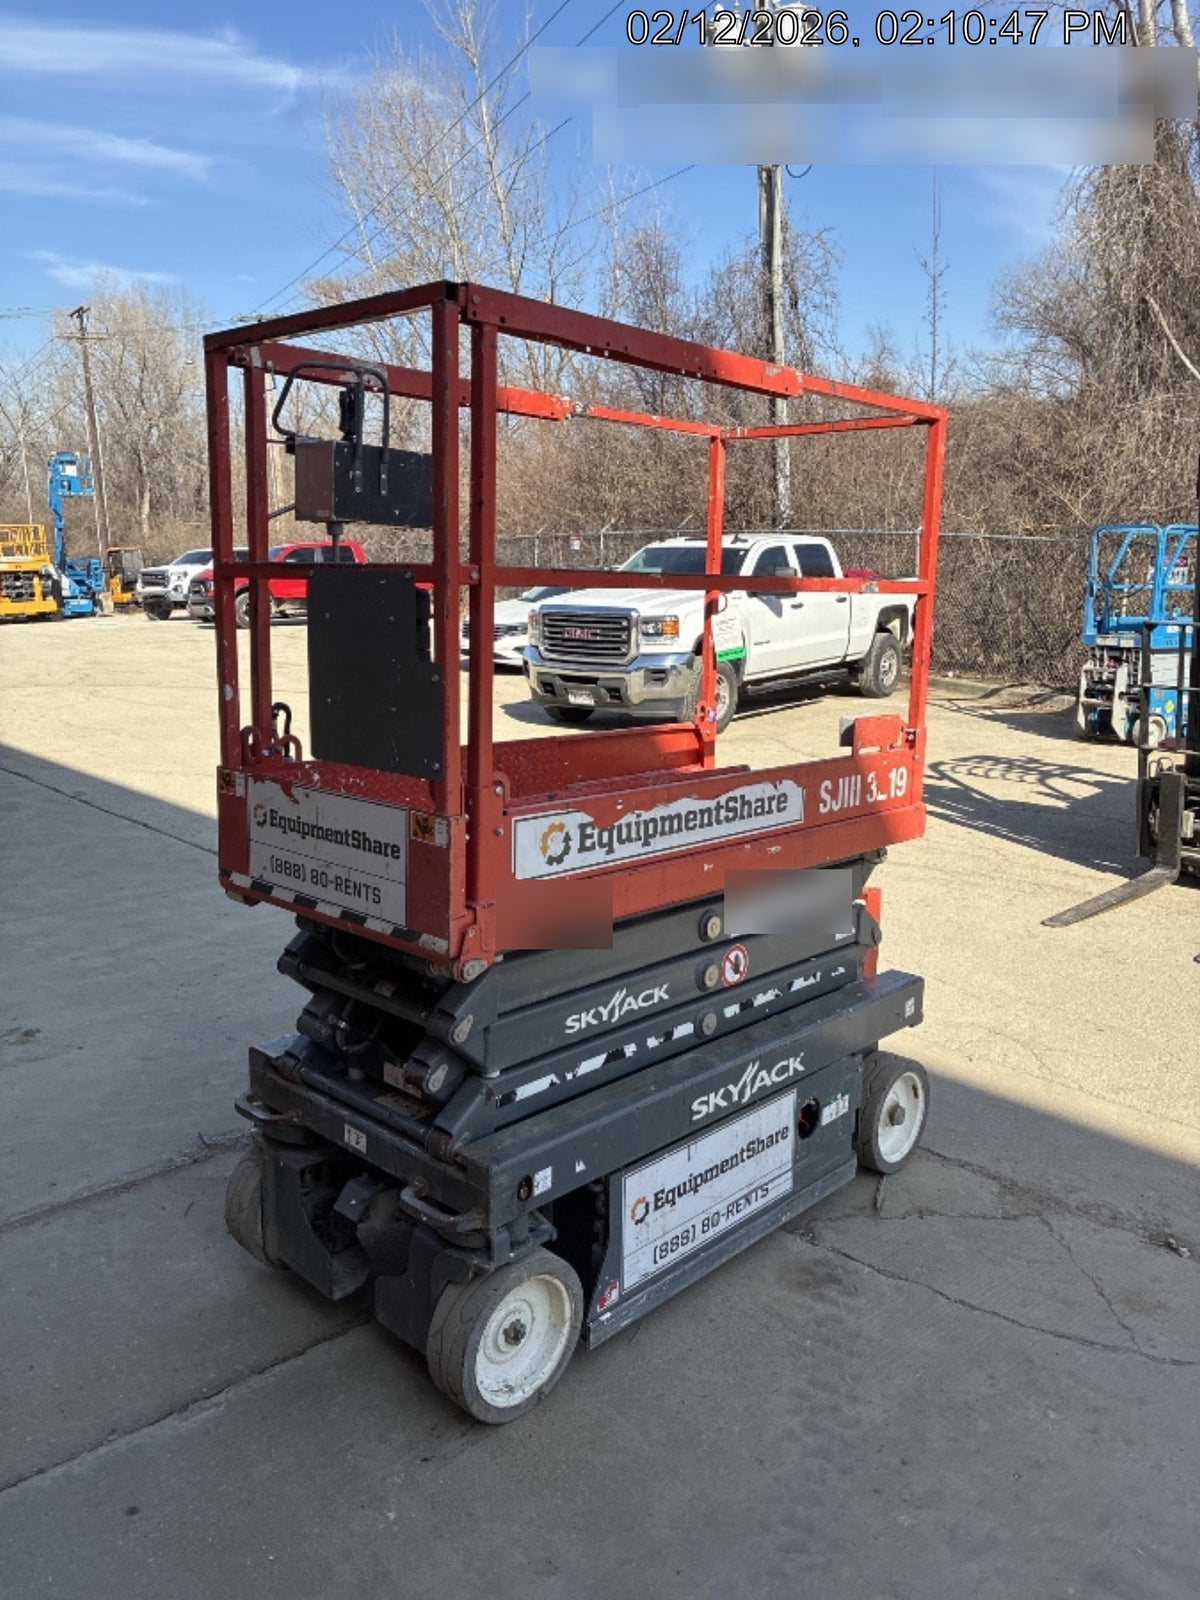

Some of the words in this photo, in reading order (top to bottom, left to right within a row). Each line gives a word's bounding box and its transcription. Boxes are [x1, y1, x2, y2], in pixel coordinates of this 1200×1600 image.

[269, 808, 400, 859] EquipmentShare
[577, 792, 788, 855] EquipmentShare
[270, 855, 306, 882] (888)
[310, 868, 381, 904] 80-RENTS
[564, 983, 670, 1034] SKYJACK
[691, 1052, 804, 1121] SKYJACK
[653, 1125, 789, 1211] EquipmentShare
[653, 1224, 696, 1264] (888)
[701, 1185, 769, 1234] 80-RENTS
